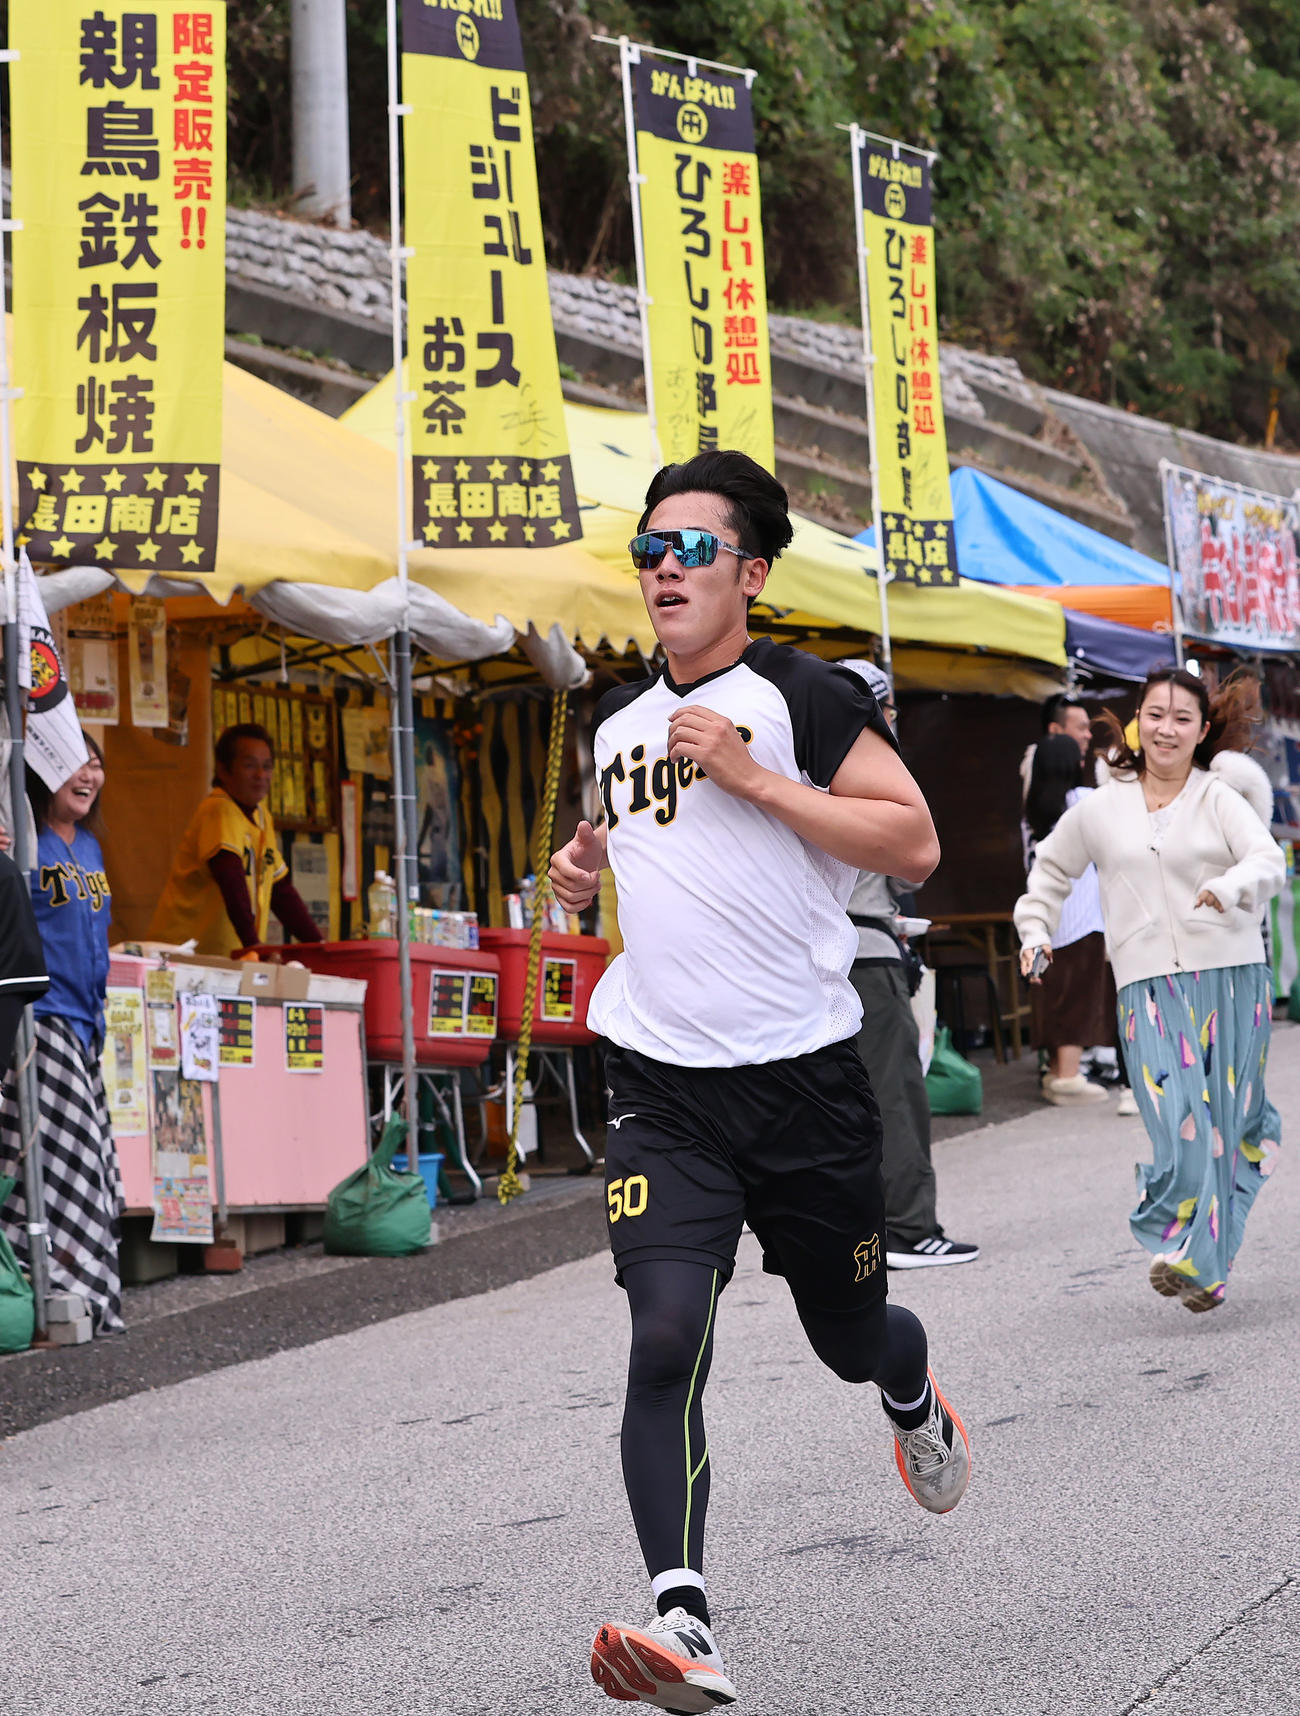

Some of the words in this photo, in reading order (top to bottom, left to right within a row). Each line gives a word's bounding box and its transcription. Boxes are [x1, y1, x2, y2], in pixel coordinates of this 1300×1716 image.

[172, 13, 213, 250] 限定販売!!
[490, 85, 532, 265] ビール
[75, 11, 161, 455] 親鳥鉄板焼
[469, 144, 521, 388] ジュース
[721, 161, 761, 385] 楽しい休憩処
[423, 317, 467, 436] お茶
[25, 494, 202, 536] 長田商店
[424, 482, 562, 518] 長田商店
[600, 725, 754, 832] Tige
[607, 1174, 649, 1224] 50
